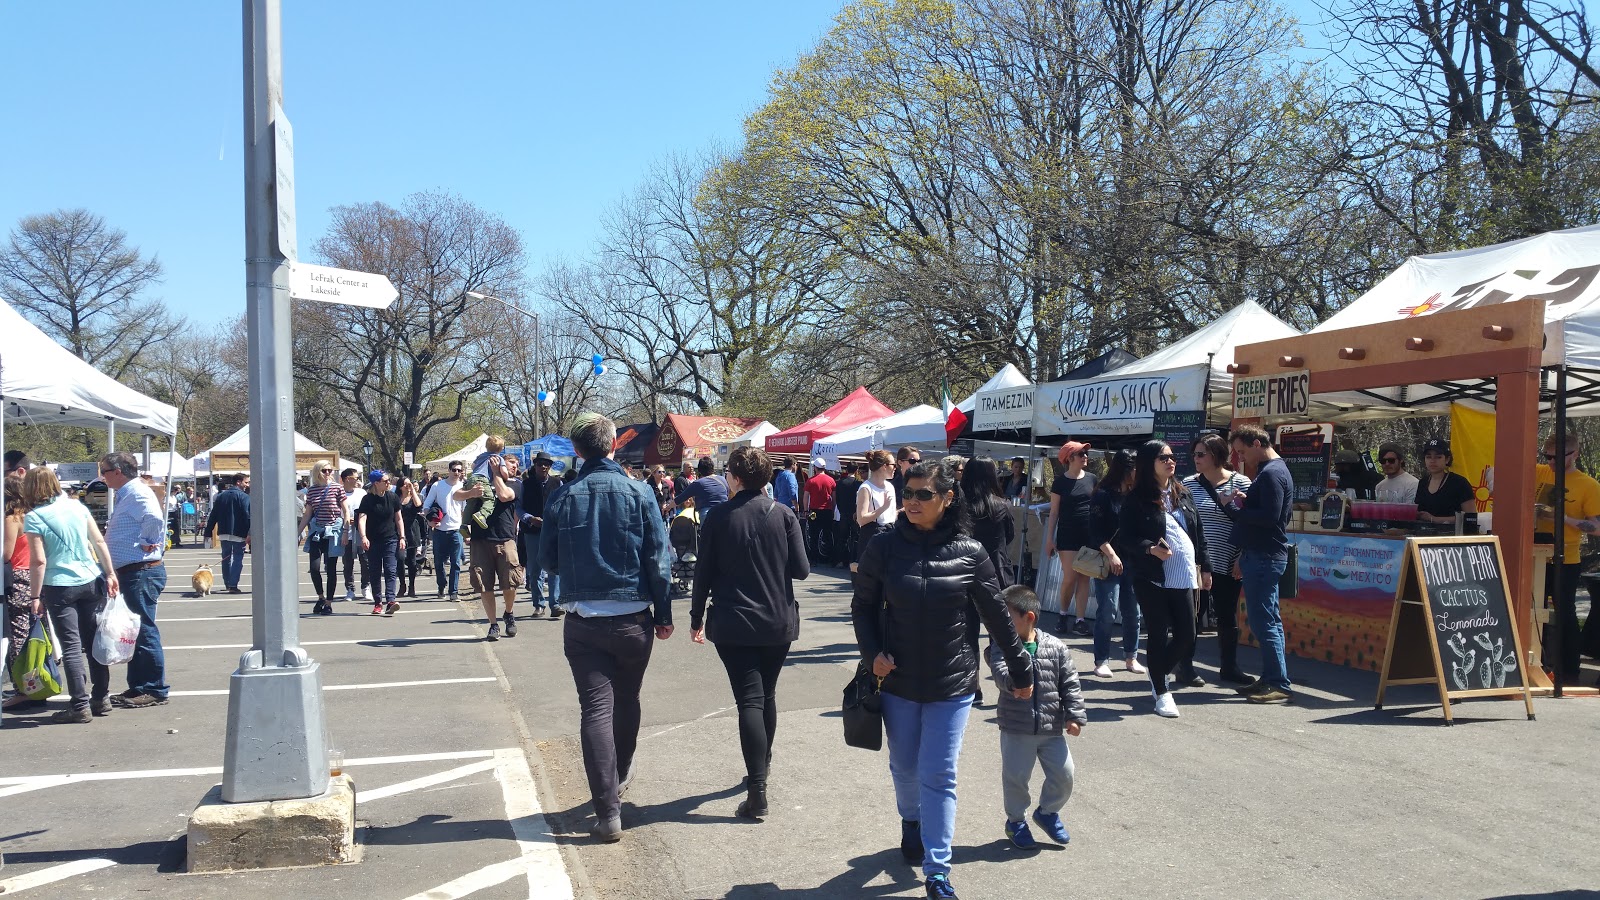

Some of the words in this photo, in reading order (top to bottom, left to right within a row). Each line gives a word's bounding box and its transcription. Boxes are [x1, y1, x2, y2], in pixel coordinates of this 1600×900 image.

[310, 272, 335, 284] LeFrak
[336, 276, 360, 287] Center
[310, 284, 341, 297] Lakeside
[1236, 379, 1267, 395] GREEN
[1267, 374, 1308, 415] FRIES
[1058, 386, 1110, 420] LUMPIA
[1119, 377, 1171, 415] SHACK
[1236, 394, 1266, 409] CHILE
[1310, 544, 1328, 555] FOOD
[1330, 546, 1340, 555] OF
[1344, 547, 1394, 560] ENCHANTMENT
[1338, 559, 1368, 568] BEAUTIFUL
[1420, 547, 1467, 586] PRICKLY
[1466, 545, 1498, 581] PEAR
[1309, 566, 1331, 577] NEW
[1350, 570, 1392, 585] MEXICO
[1439, 588, 1488, 607] CACTUS
[1436, 609, 1499, 632] Lemonade
